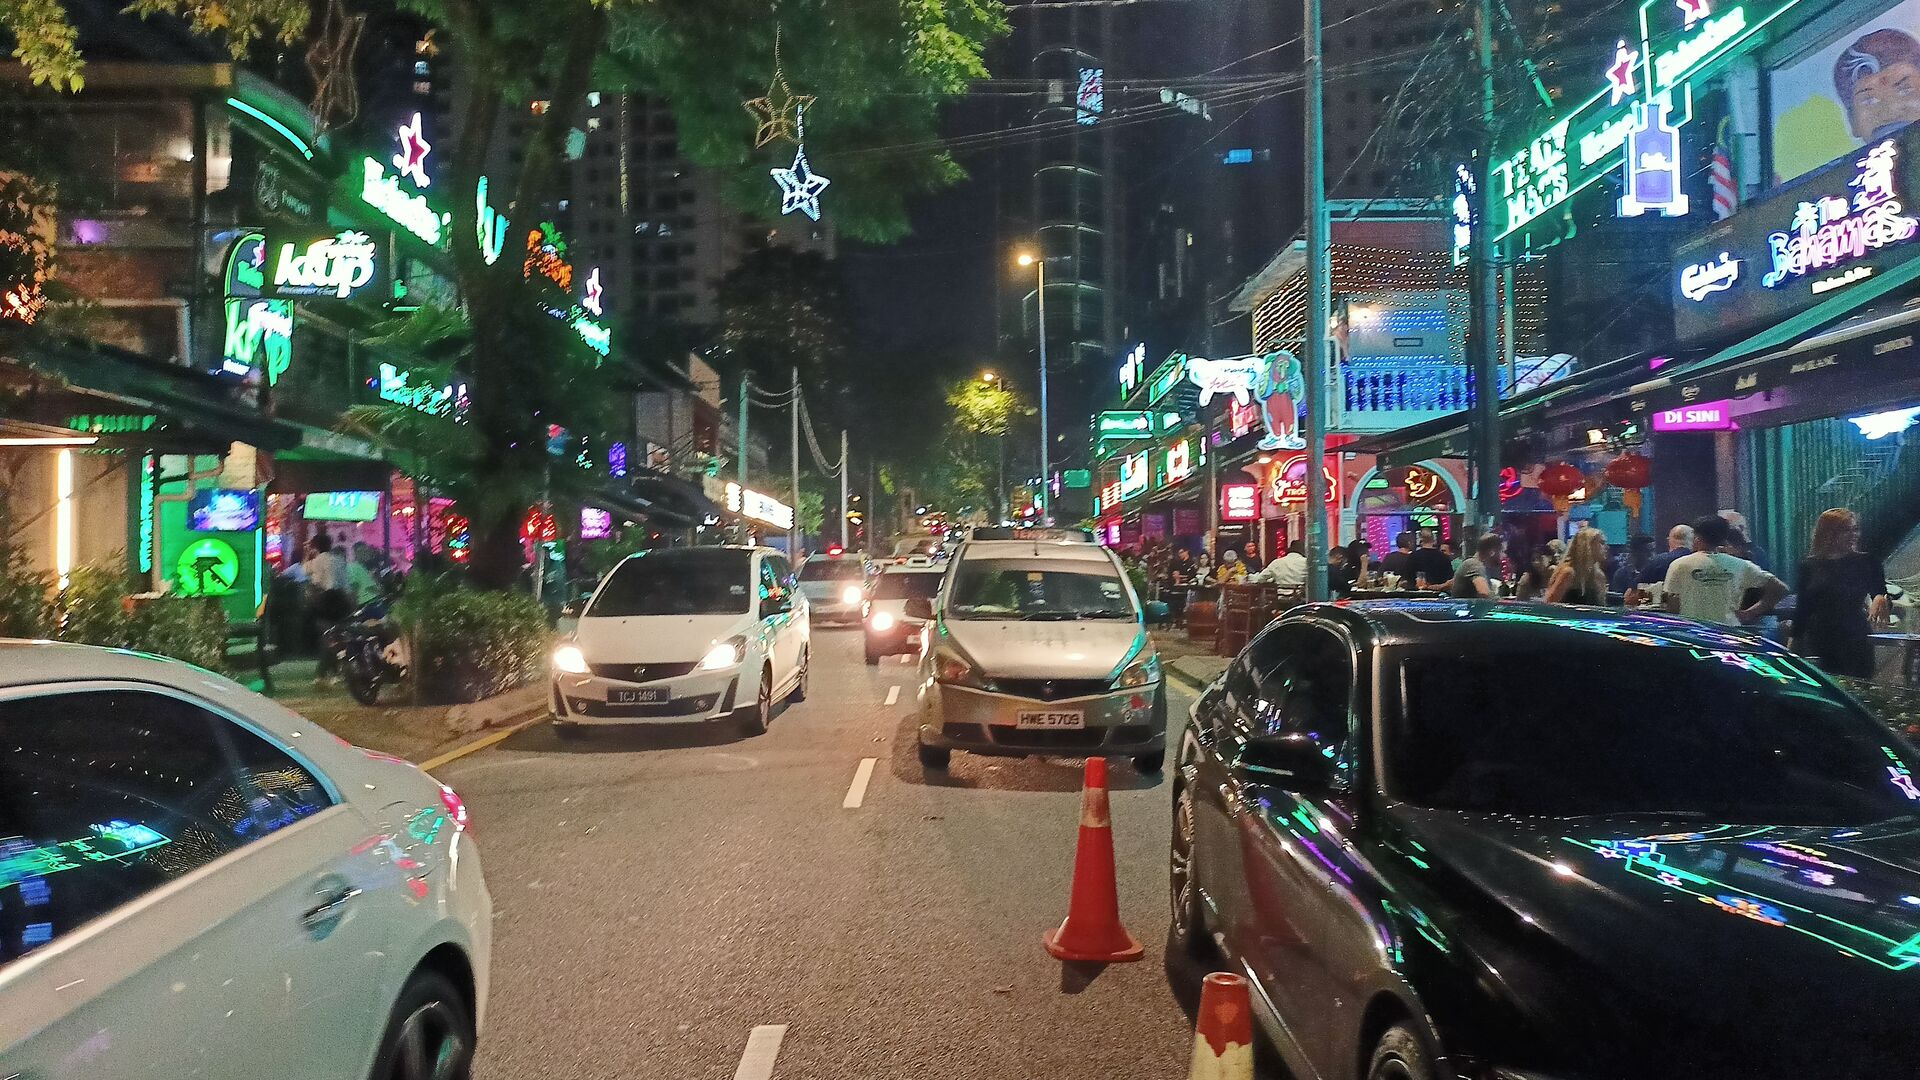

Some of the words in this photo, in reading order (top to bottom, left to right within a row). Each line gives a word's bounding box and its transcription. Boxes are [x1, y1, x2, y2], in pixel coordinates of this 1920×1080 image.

[1761, 200, 1919, 288] Bahamas
[1664, 410, 1683, 424] DI
[1686, 409, 1721, 423] SINI
[619, 691, 636, 702] TCJ
[1020, 713, 1046, 725] HWE
